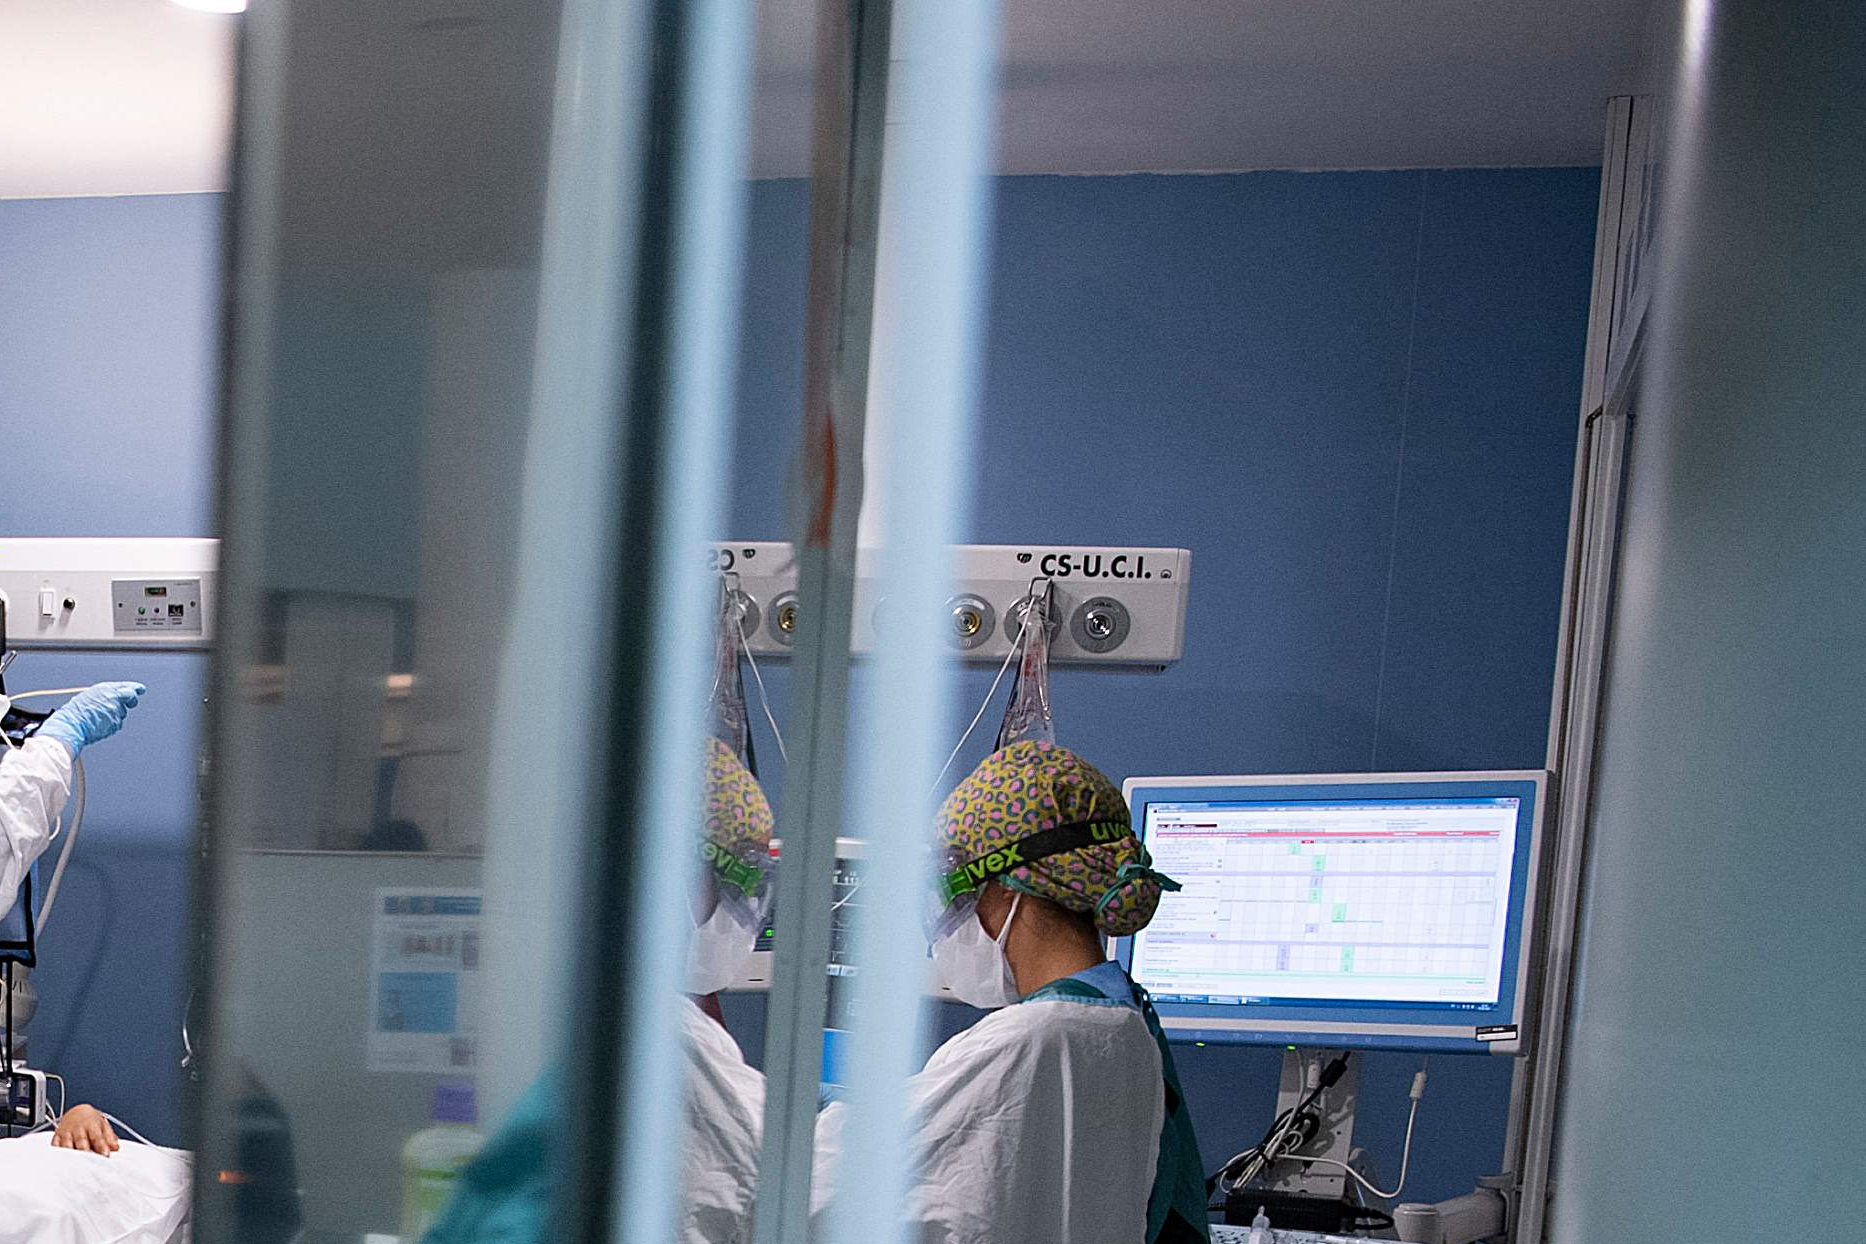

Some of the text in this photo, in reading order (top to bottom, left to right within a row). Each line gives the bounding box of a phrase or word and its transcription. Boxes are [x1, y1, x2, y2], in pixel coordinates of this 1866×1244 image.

[1040, 554, 1152, 579] CS-U.C.I.
[1090, 821, 1130, 841] uve
[967, 844, 1024, 879] vex
